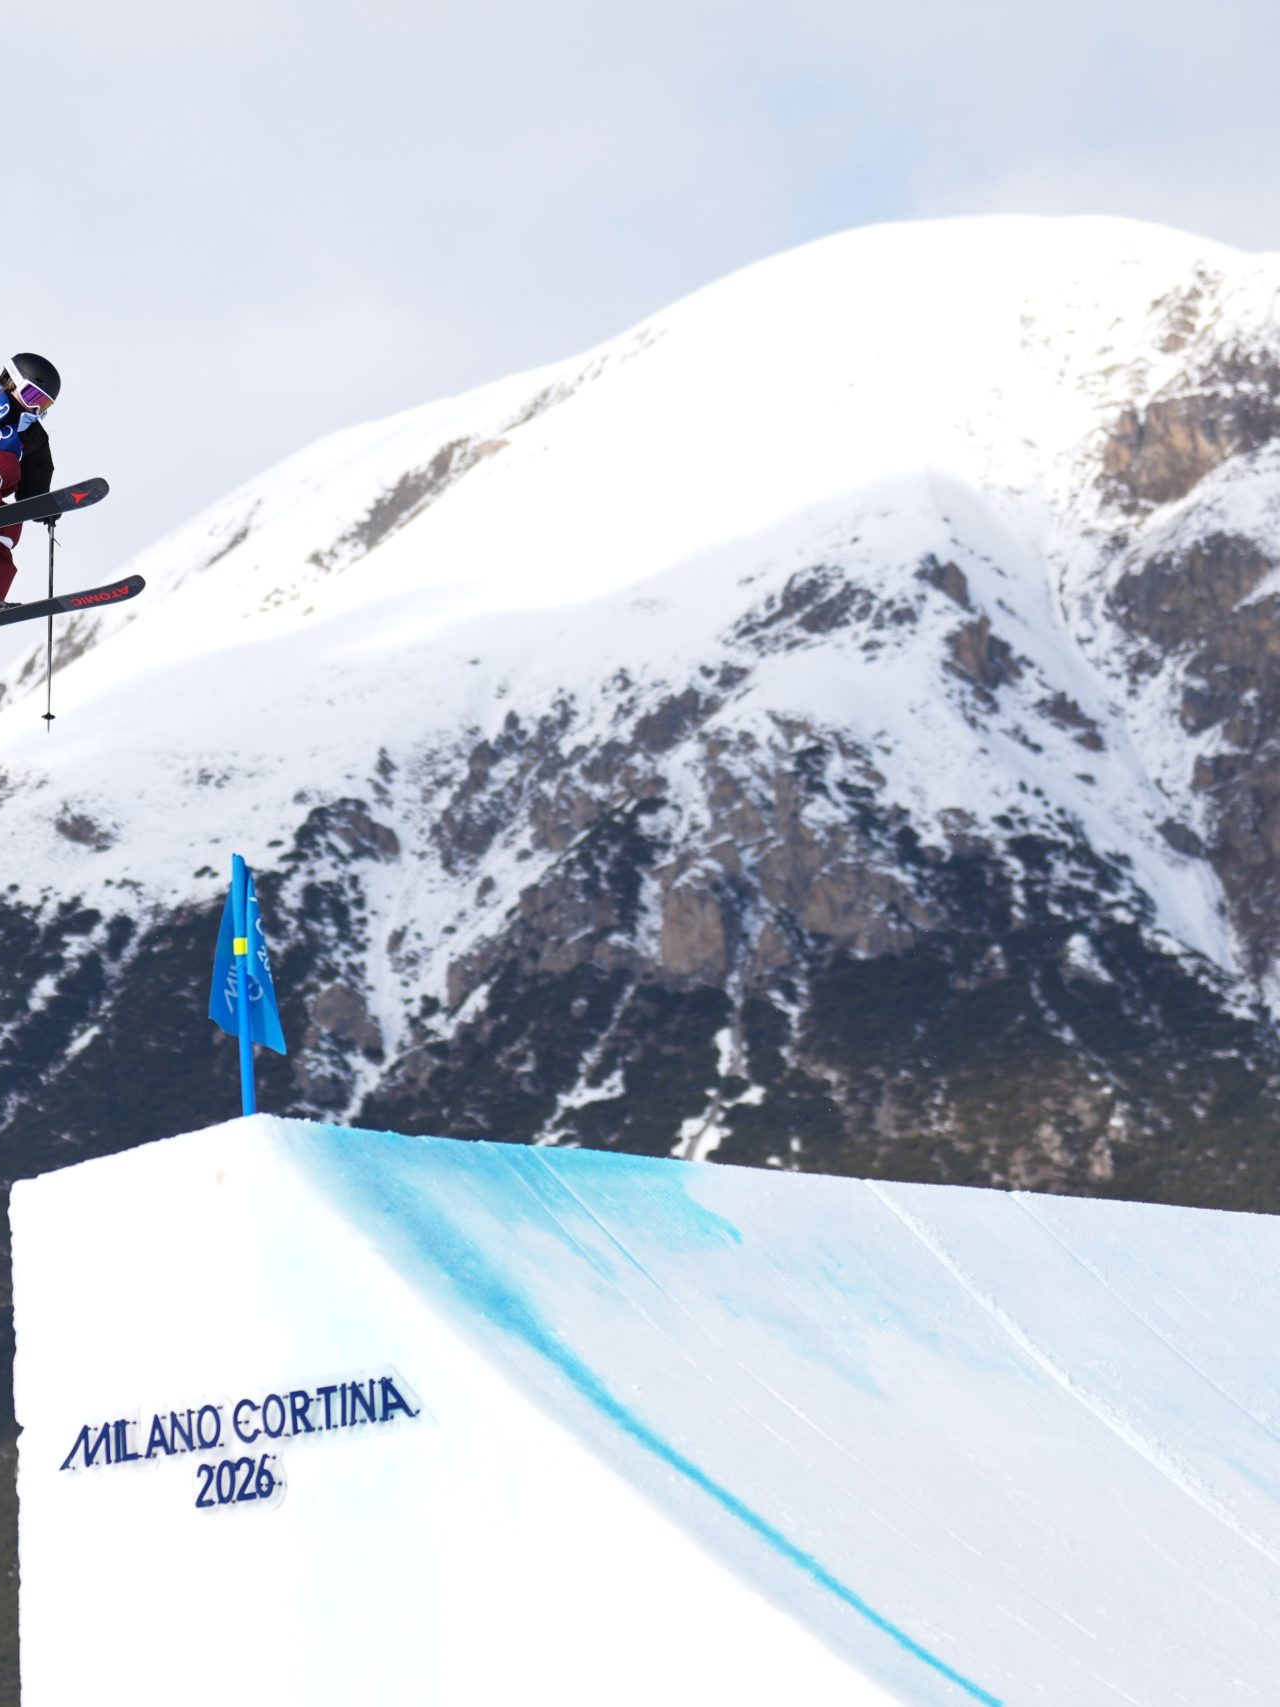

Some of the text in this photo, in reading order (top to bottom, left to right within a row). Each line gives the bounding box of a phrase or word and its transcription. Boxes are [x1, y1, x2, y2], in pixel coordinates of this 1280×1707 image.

[71, 585, 129, 606] ATOMIC
[59, 1376, 421, 1471] MILANO CORTINA
[195, 1453, 277, 1508] 2026
